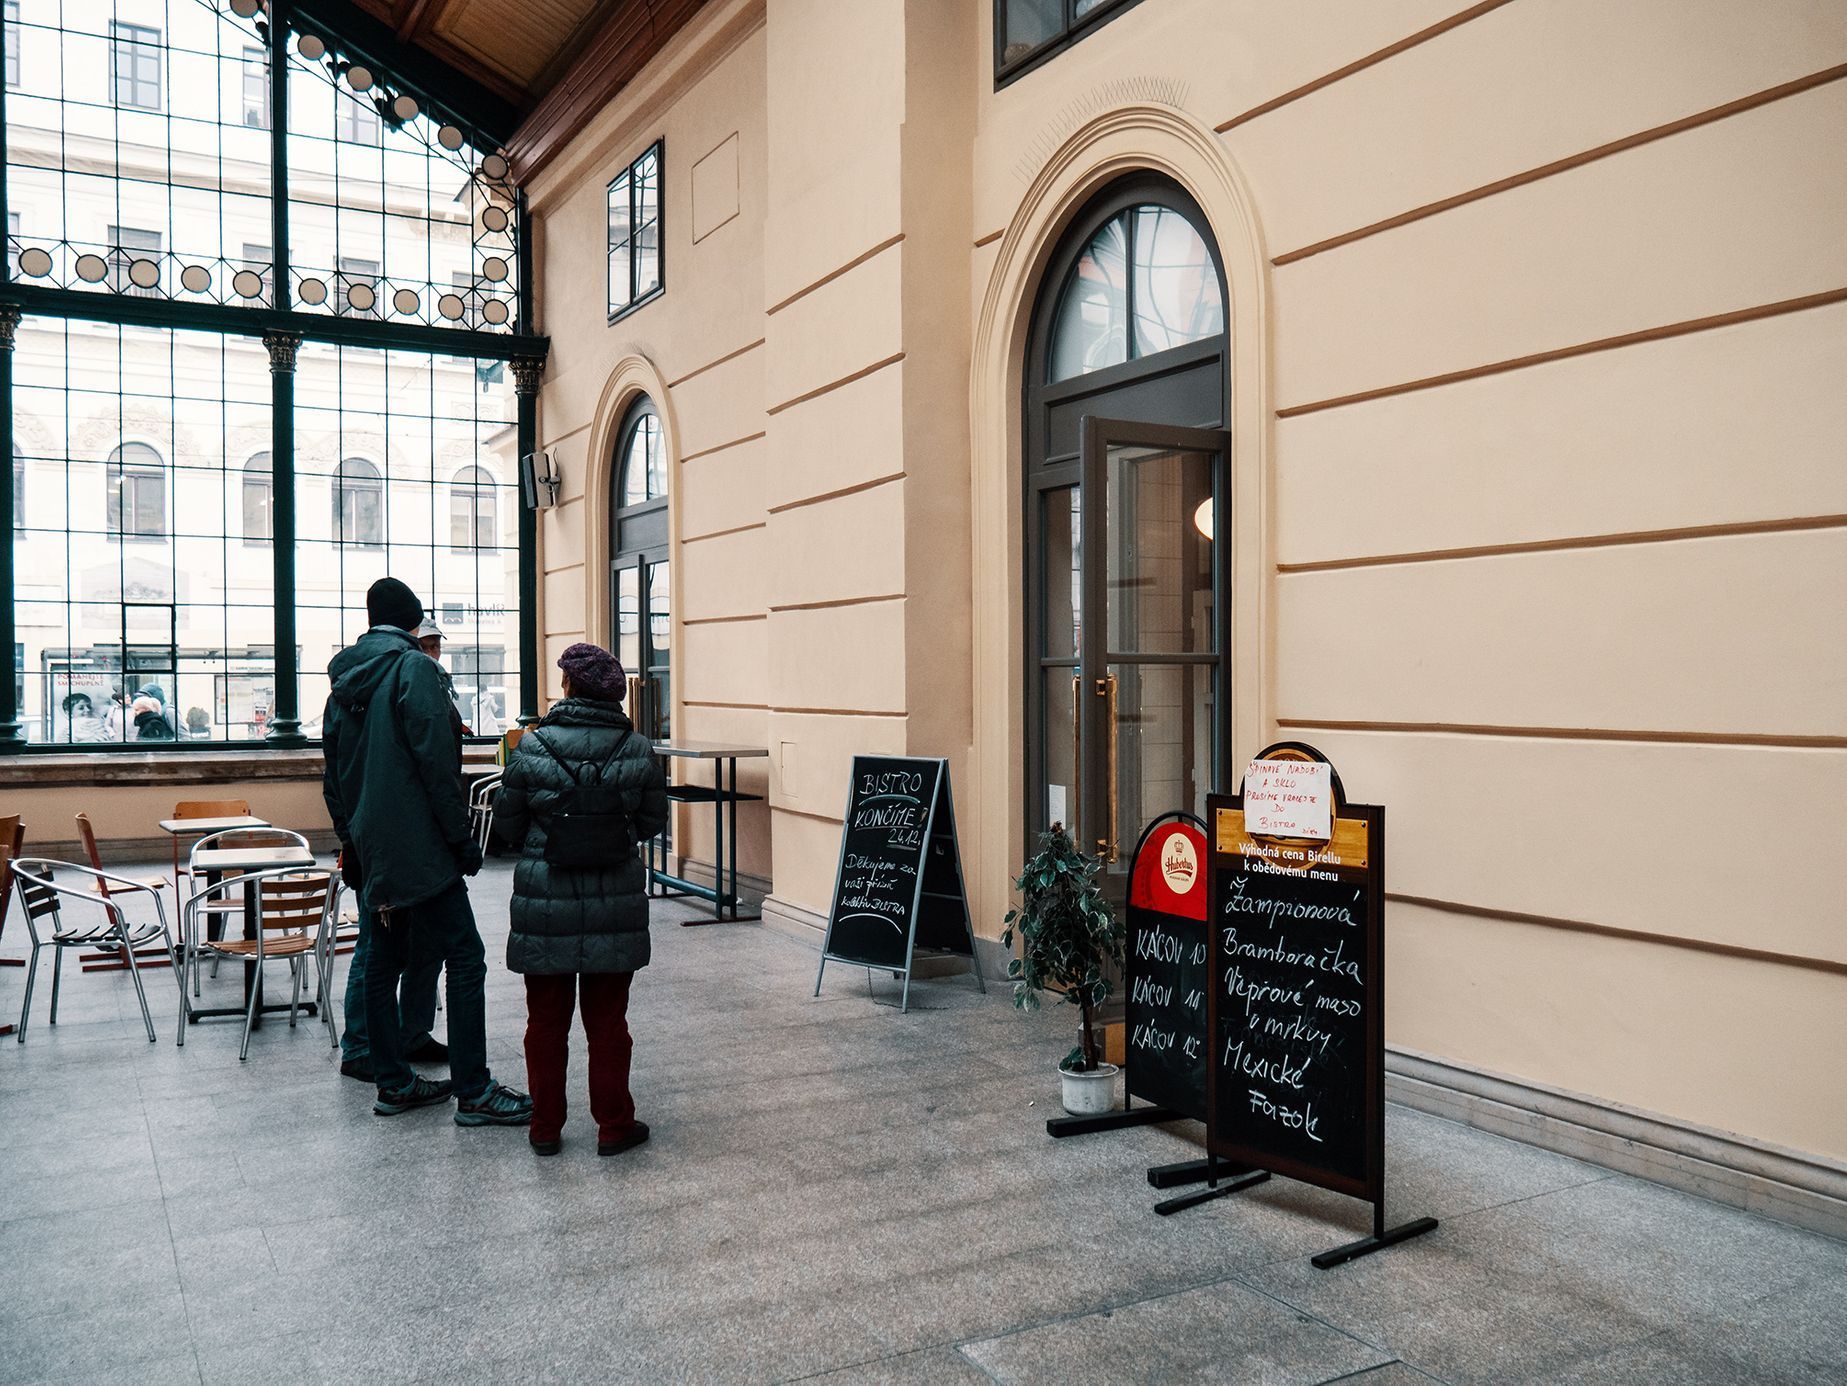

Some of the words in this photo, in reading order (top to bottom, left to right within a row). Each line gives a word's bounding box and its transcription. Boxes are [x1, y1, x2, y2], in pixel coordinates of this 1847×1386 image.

[860, 771, 922, 795] BISTRO
[845, 853, 896, 881] Děkujeme
[900, 864, 917, 875] za
[1239, 843, 1279, 858] Výhodná
[1282, 850, 1304, 860] cena
[1308, 850, 1341, 864] Birellu
[1244, 859, 1250, 871] k
[1252, 861, 1307, 878] obědovému
[1310, 870, 1338, 881] menu
[1225, 875, 1361, 929] Žampionová
[1135, 924, 1183, 964] KÁCOV
[1223, 927, 1364, 986] Bramboračka
[1132, 975, 1173, 1007] KÁCOV
[1224, 965, 1315, 1016] Vepřové
[1315, 995, 1361, 1016] maso
[1132, 1018, 1176, 1051] KÁCOV
[1264, 1015, 1332, 1055] mrkvy
[1224, 1036, 1311, 1089] Mexické
